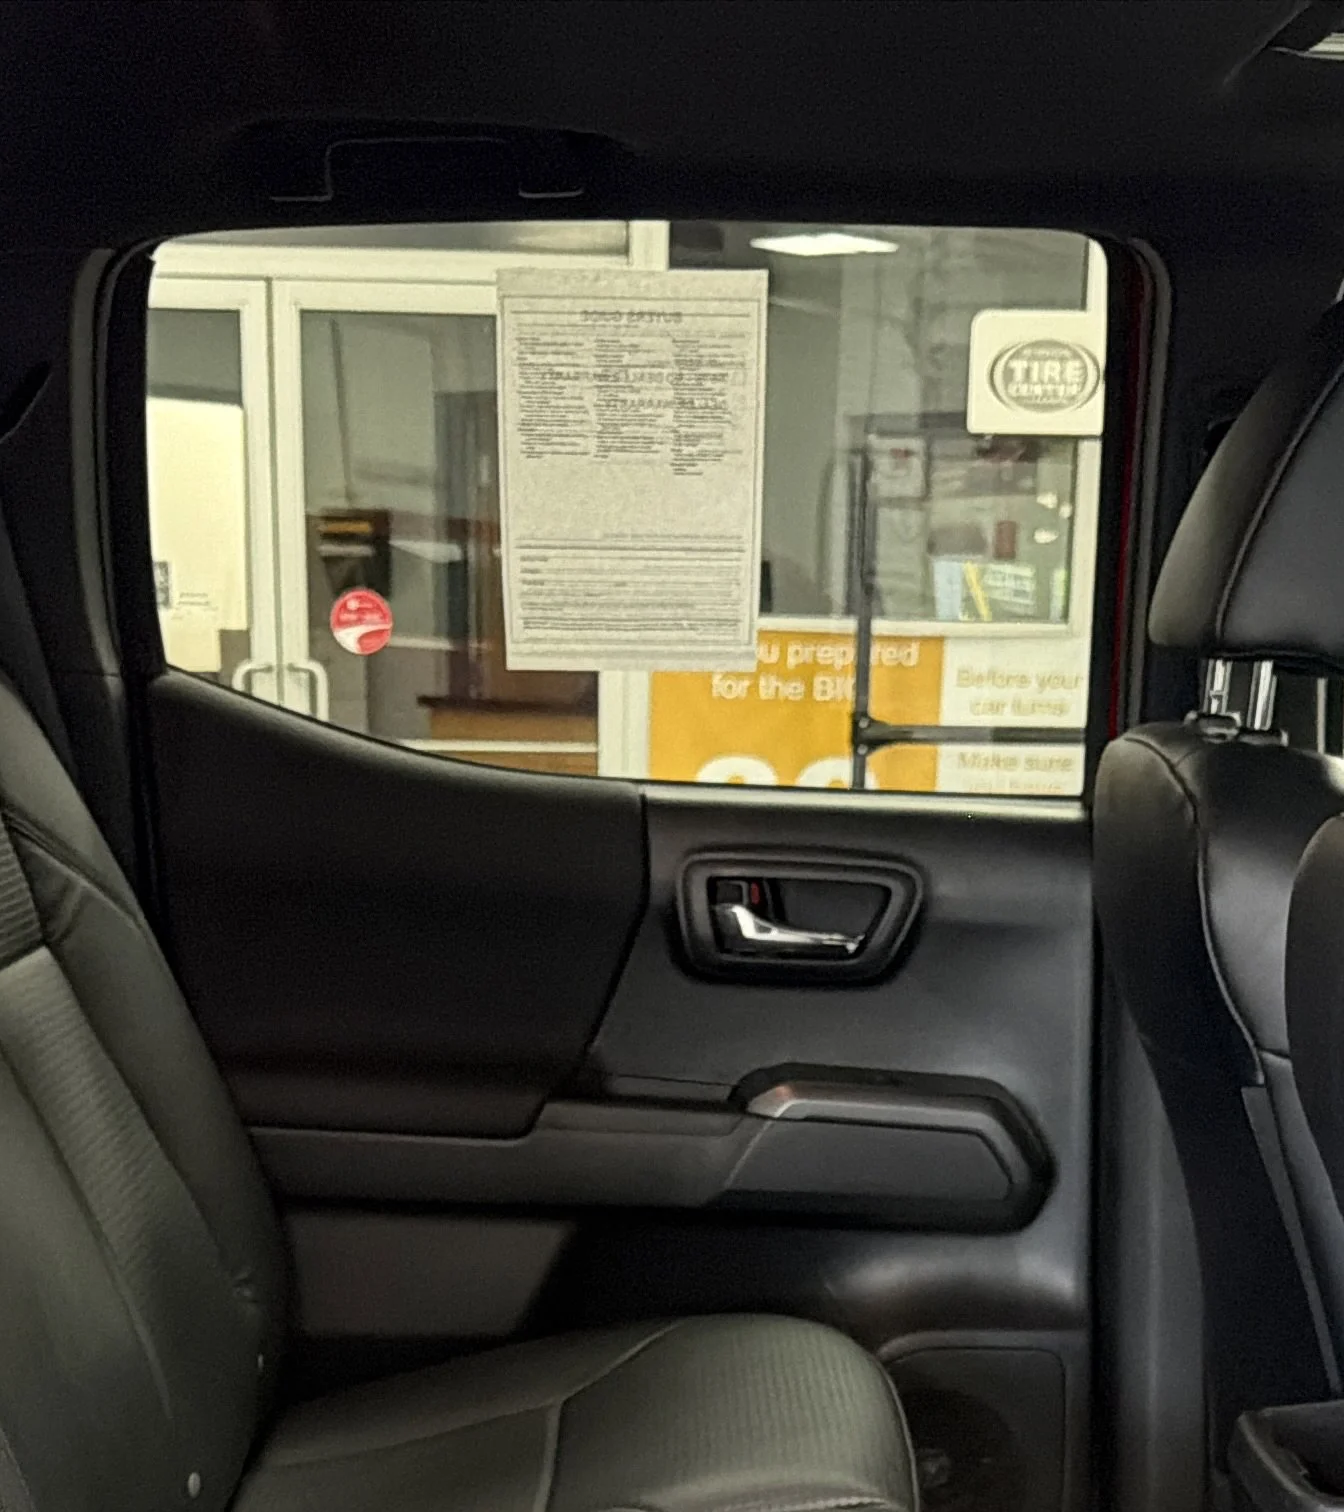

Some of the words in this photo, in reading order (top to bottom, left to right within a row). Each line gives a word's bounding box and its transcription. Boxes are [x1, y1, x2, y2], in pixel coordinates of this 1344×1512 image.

[1007, 359, 1085, 383] TIRE
[787, 640, 920, 670] prepred
[712, 672, 750, 699] for
[759, 673, 805, 700] the
[956, 668, 1031, 689] Before
[1035, 673, 1083, 694] your
[958, 751, 1019, 772] Make
